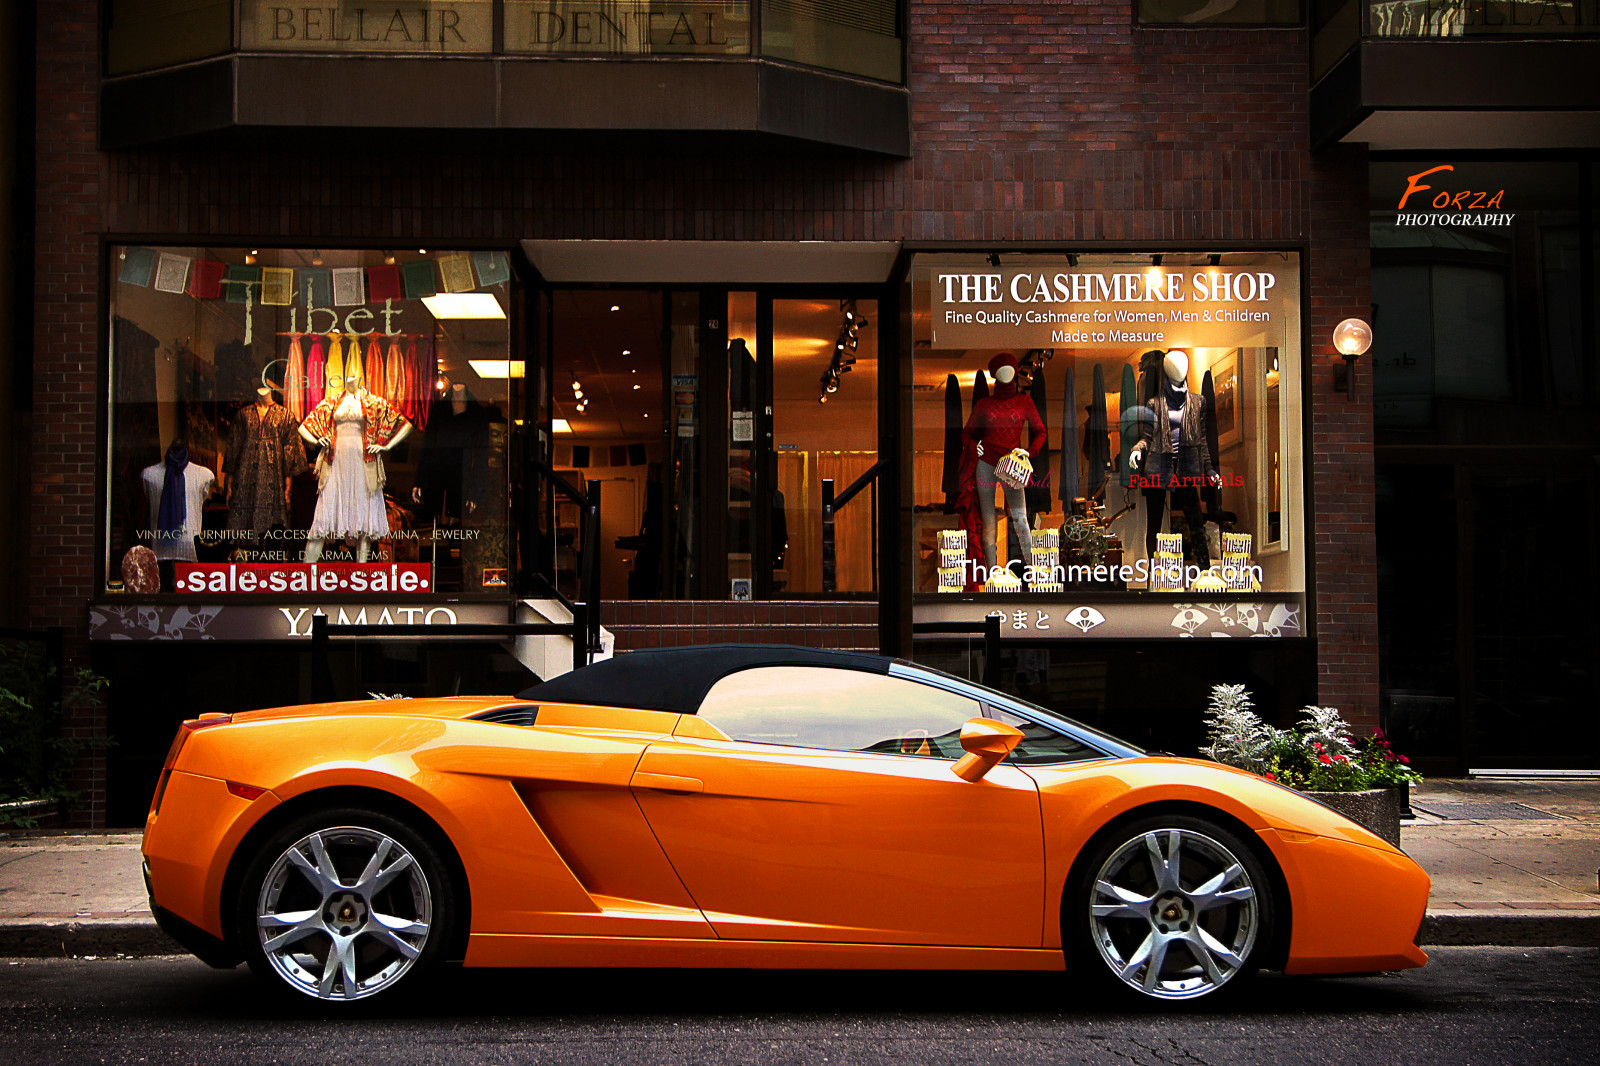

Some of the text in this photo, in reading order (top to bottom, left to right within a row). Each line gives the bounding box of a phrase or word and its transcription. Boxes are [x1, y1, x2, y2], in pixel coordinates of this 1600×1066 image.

[268, 7, 728, 45] BELLAIR DENTAL
[938, 271, 1275, 303] THE CASHMERE SHOP
[218, 277, 404, 346] Tibet
[945, 309, 1270, 326] Fine Quality Cashmere for Women, Men & Children
[1051, 329, 1165, 343] Made to Measure
[1128, 473, 1244, 488] Fall Arrivals
[429, 529, 480, 541] JEWELRY
[236, 550, 288, 561] APPAREL
[298, 550, 354, 561] DARMA
[956, 558, 1263, 588] TheCashmereShop.com
